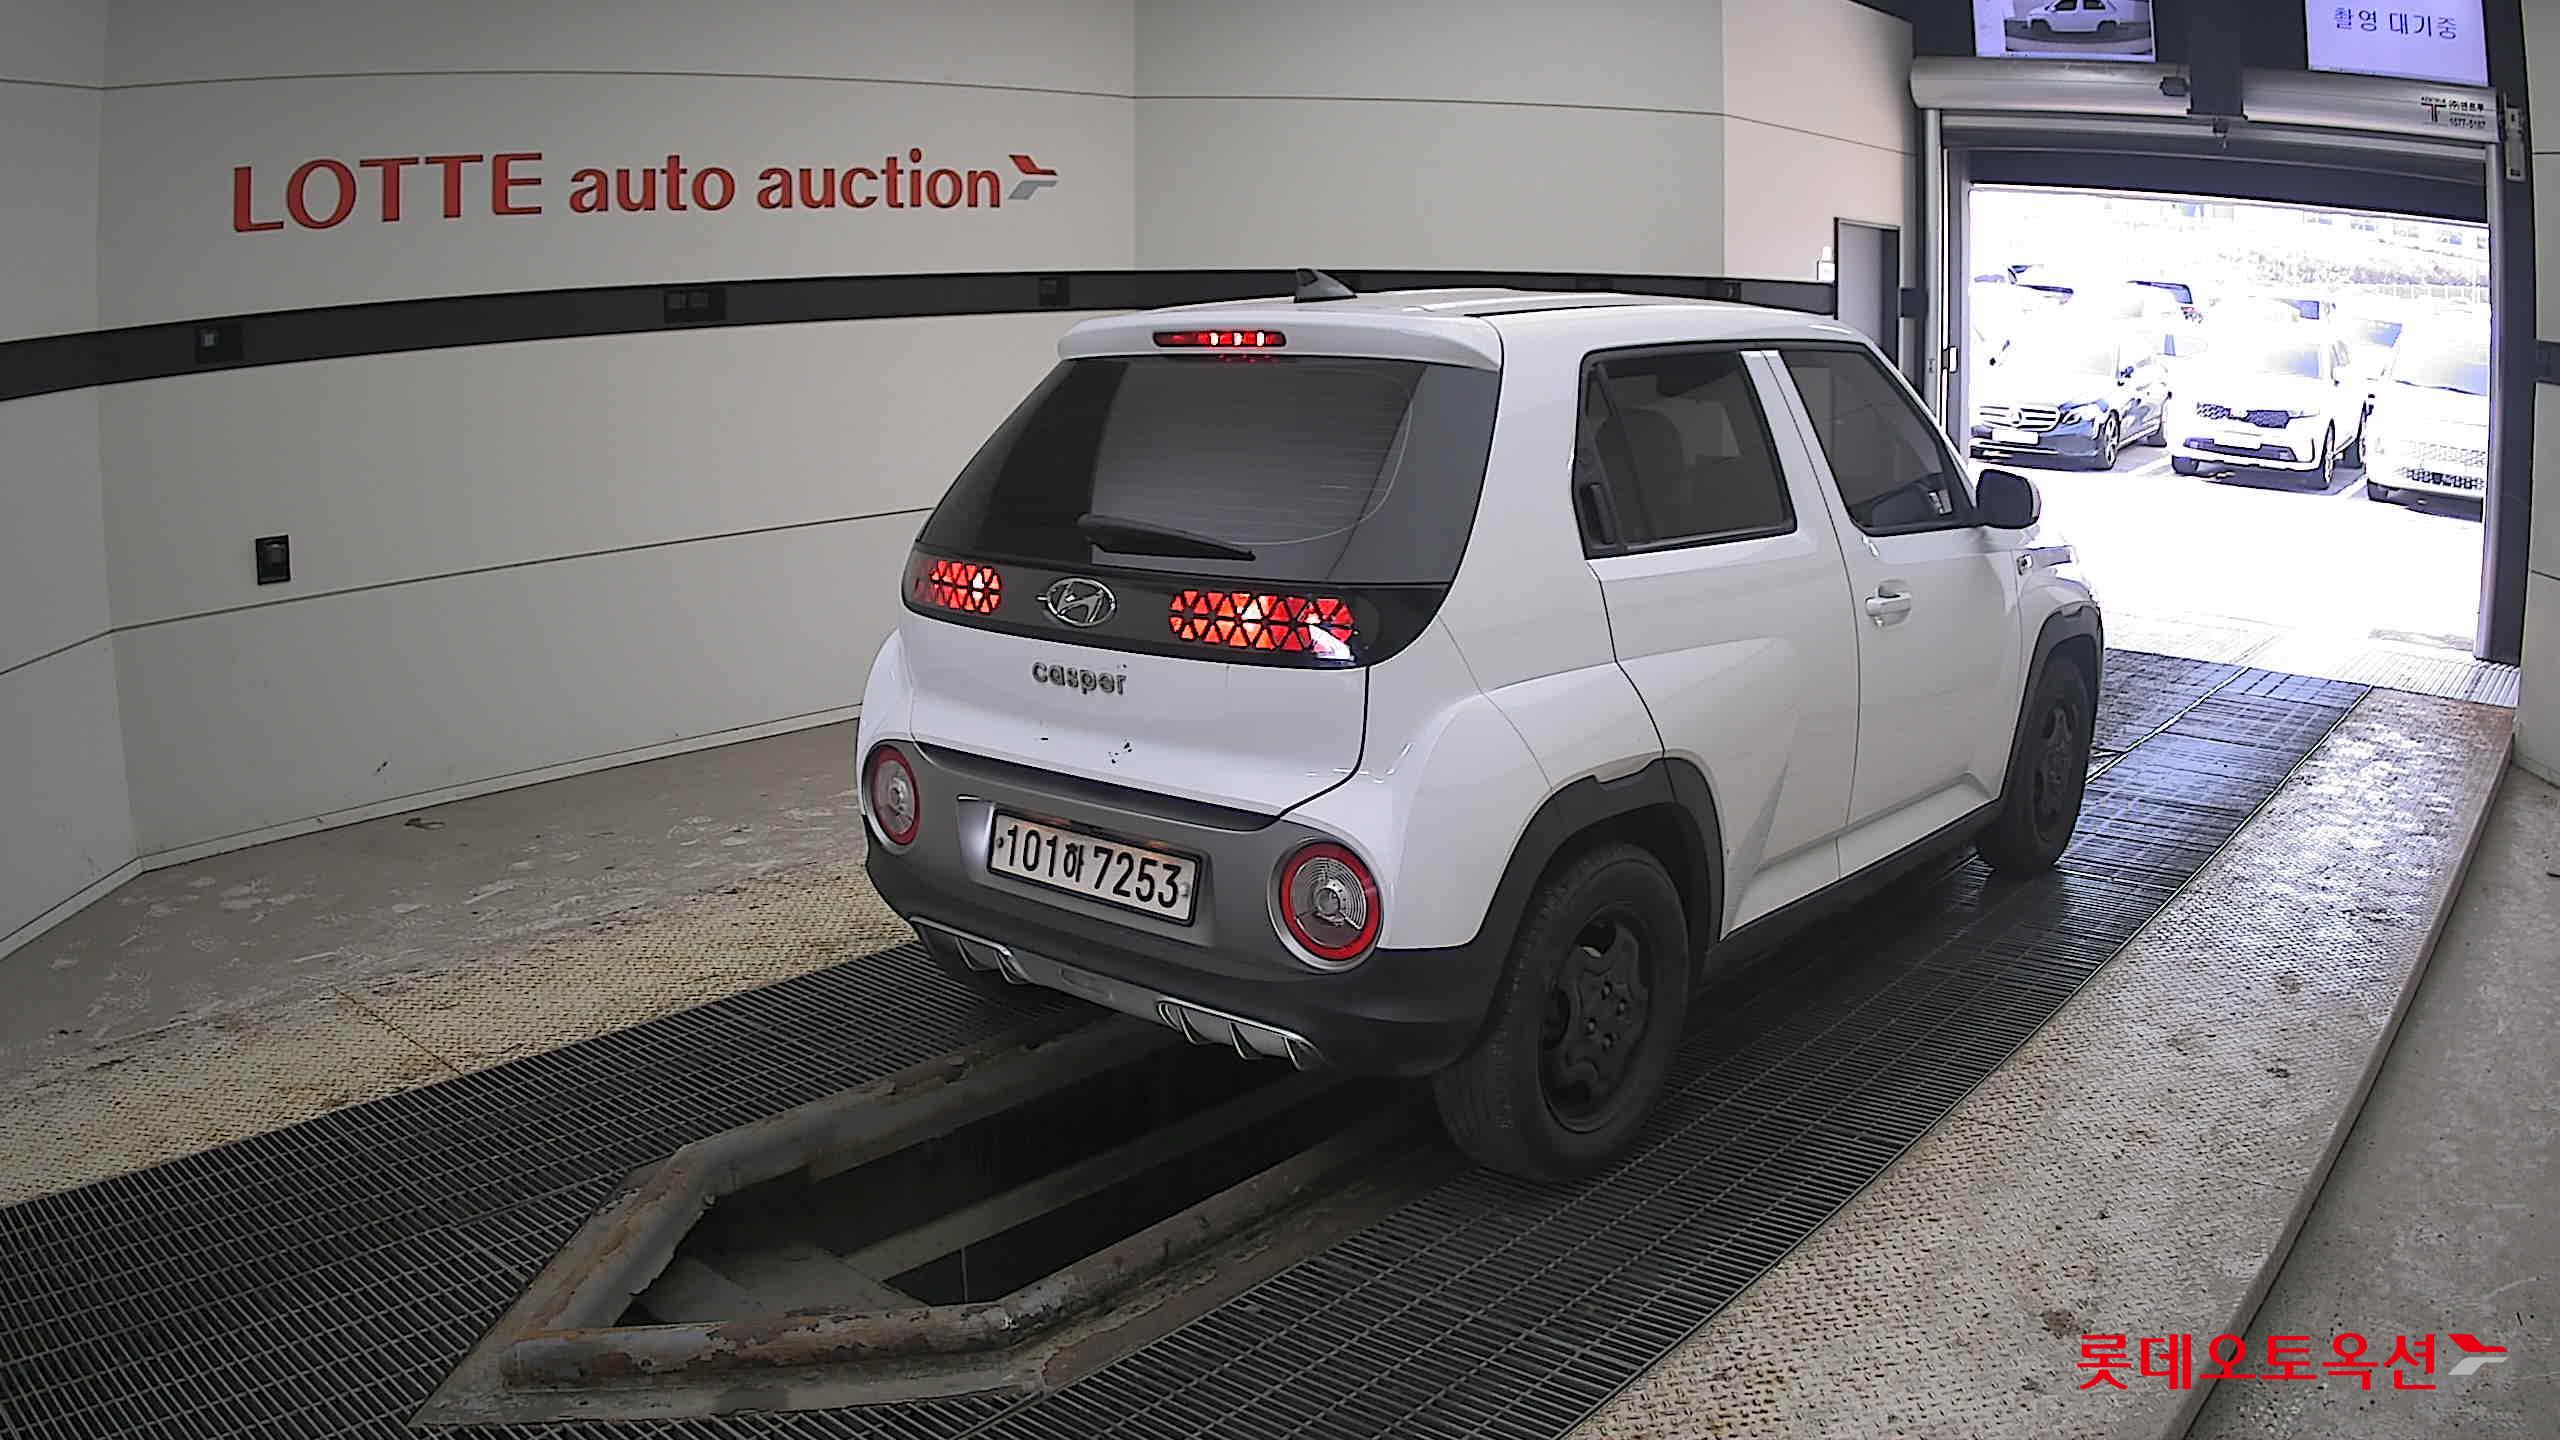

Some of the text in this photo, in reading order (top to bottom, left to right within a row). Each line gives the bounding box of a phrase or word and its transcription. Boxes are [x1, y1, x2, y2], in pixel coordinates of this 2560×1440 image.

[2389, 12, 2457, 40] 대기중
[234, 148, 1001, 232] LOTTE auto auction
[1032, 661, 1128, 696] casper
[1093, 845, 1182, 908] 7253
